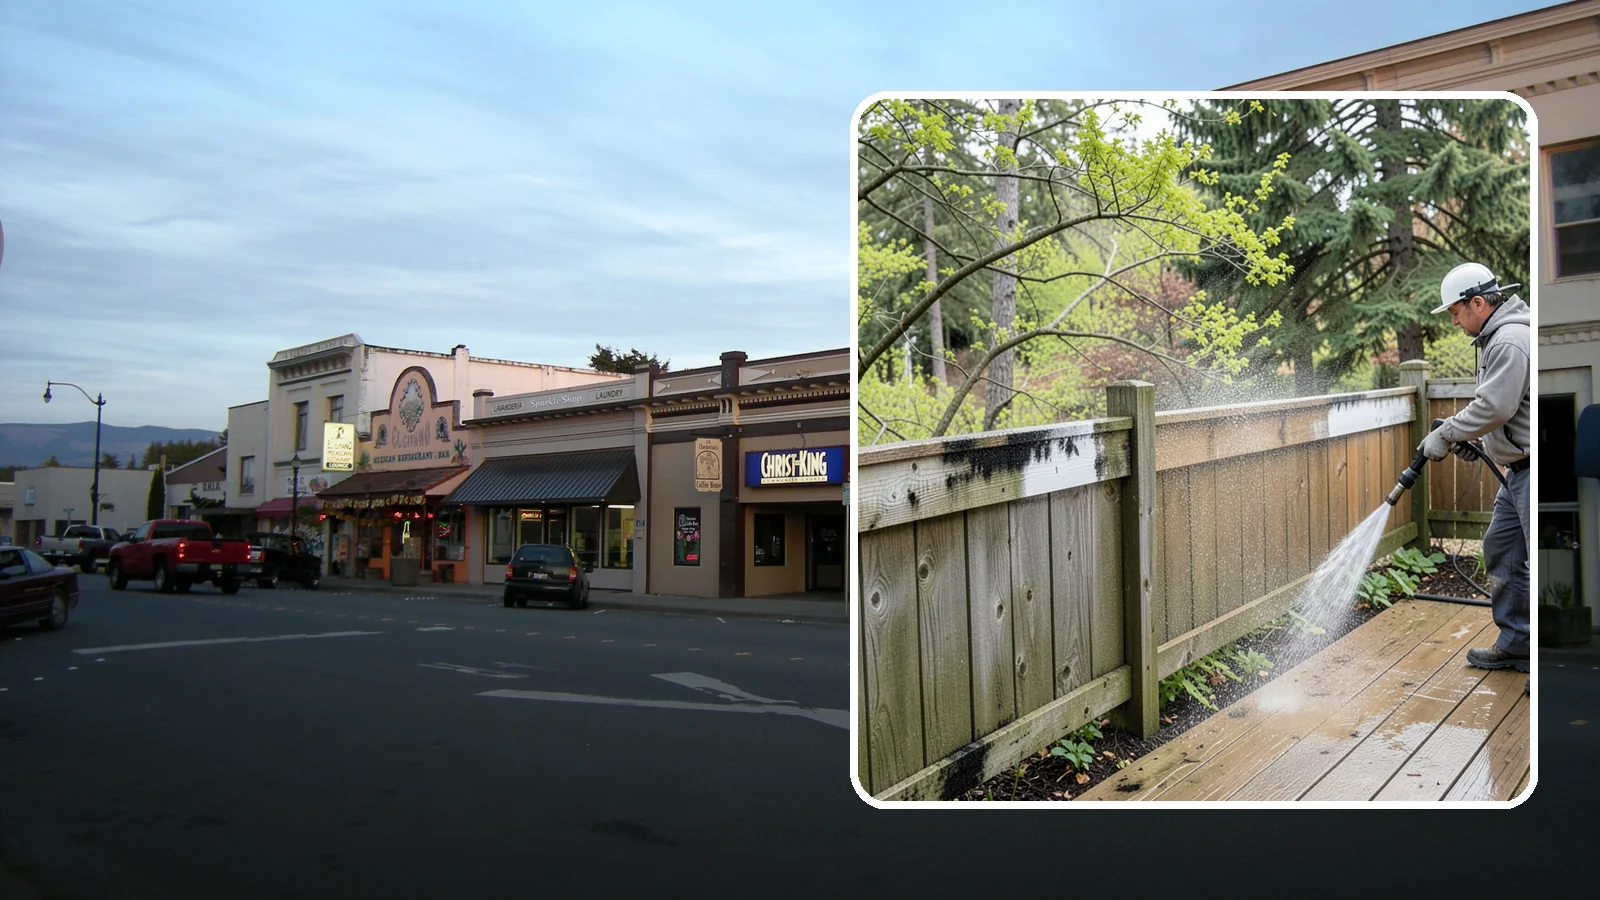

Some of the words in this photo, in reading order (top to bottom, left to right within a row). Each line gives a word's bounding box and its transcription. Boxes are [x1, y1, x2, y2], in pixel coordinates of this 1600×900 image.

[493, 402, 522, 412] LAVANDERIA
[530, 398, 560, 409] Sparkle
[562, 395, 582, 406] Shop
[595, 389, 623, 399] LAUNDRY
[373, 454, 396, 464] MEXICAN
[397, 451, 433, 462] RESTAURANT
[438, 450, 450, 459] BAR
[799, 450, 827, 476] KING
[710, 481, 721, 489] House
